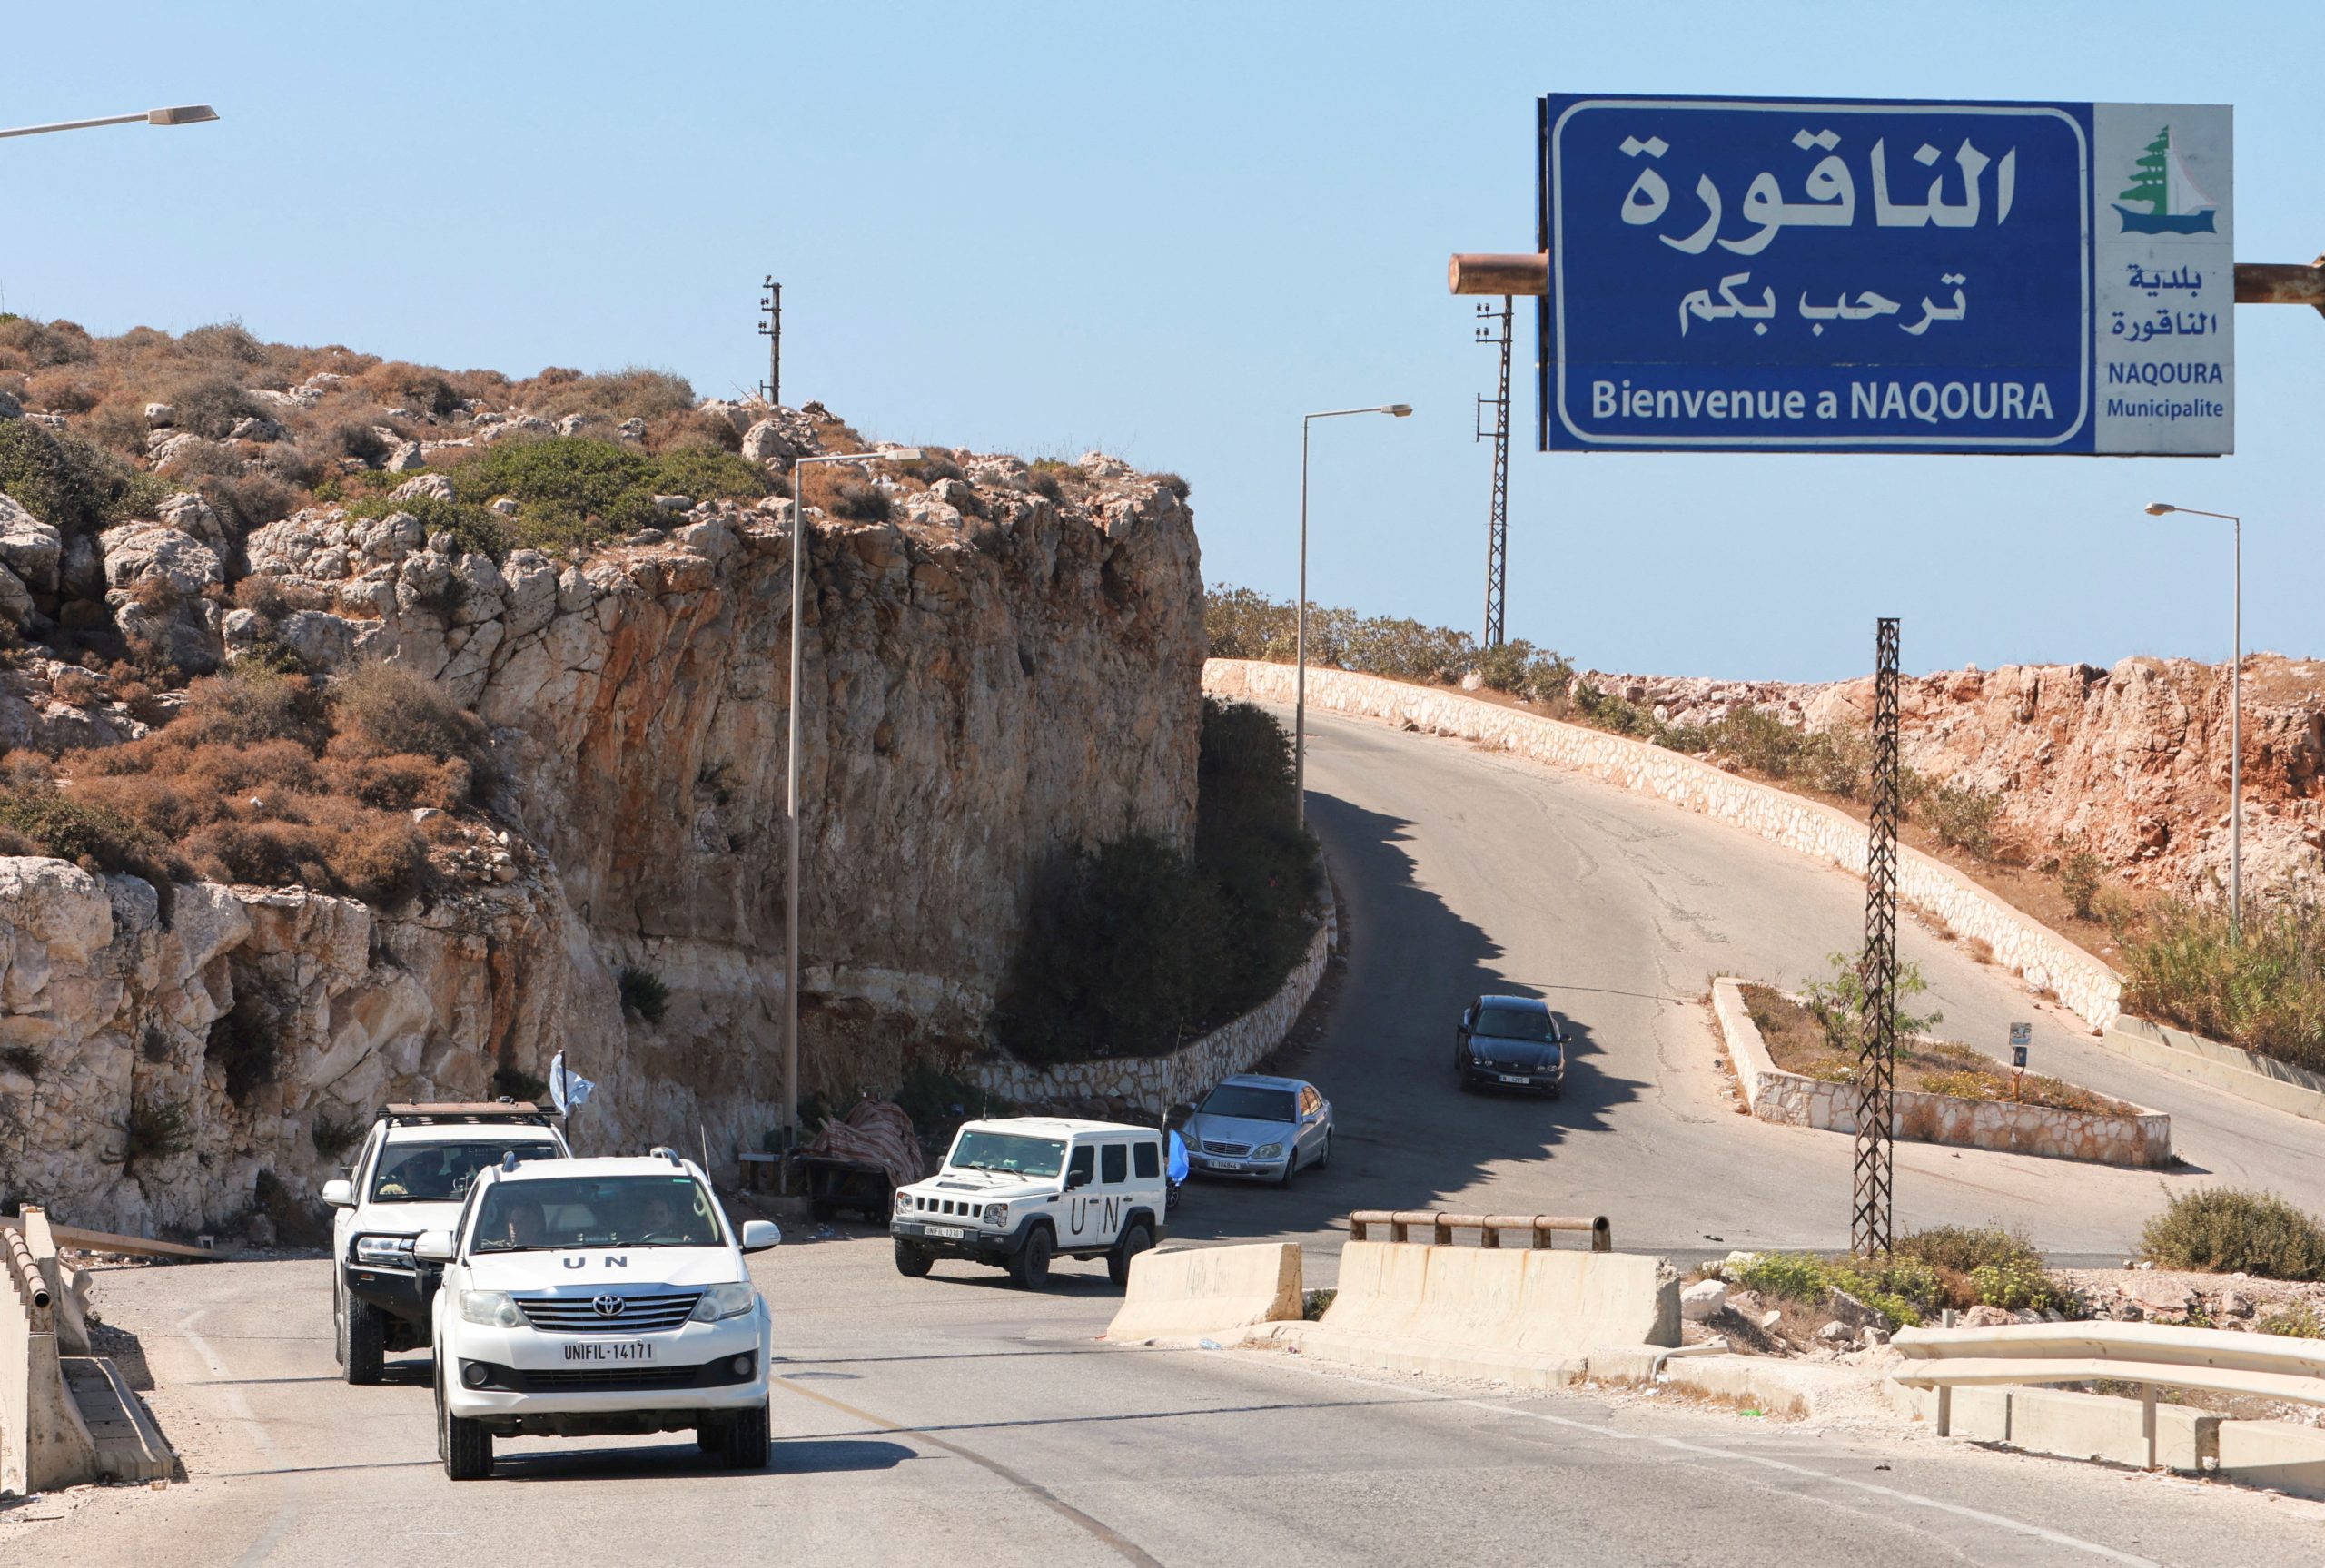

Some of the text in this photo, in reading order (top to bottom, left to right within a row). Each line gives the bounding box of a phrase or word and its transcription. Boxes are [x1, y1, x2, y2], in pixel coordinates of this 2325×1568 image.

[1620, 129, 2015, 255] الناقورة
[2127, 263, 2202, 298] بلدية
[1679, 272, 1966, 336] ترحب بكم
[2112, 309, 2217, 342] الناقورة
[2109, 362, 2223, 387] NAQOURA
[1593, 380, 2053, 423] Bienvenue a NAQOURA
[2107, 399, 2223, 421] Municipalite
[564, 1343, 652, 1360] UNIFIL-14171
